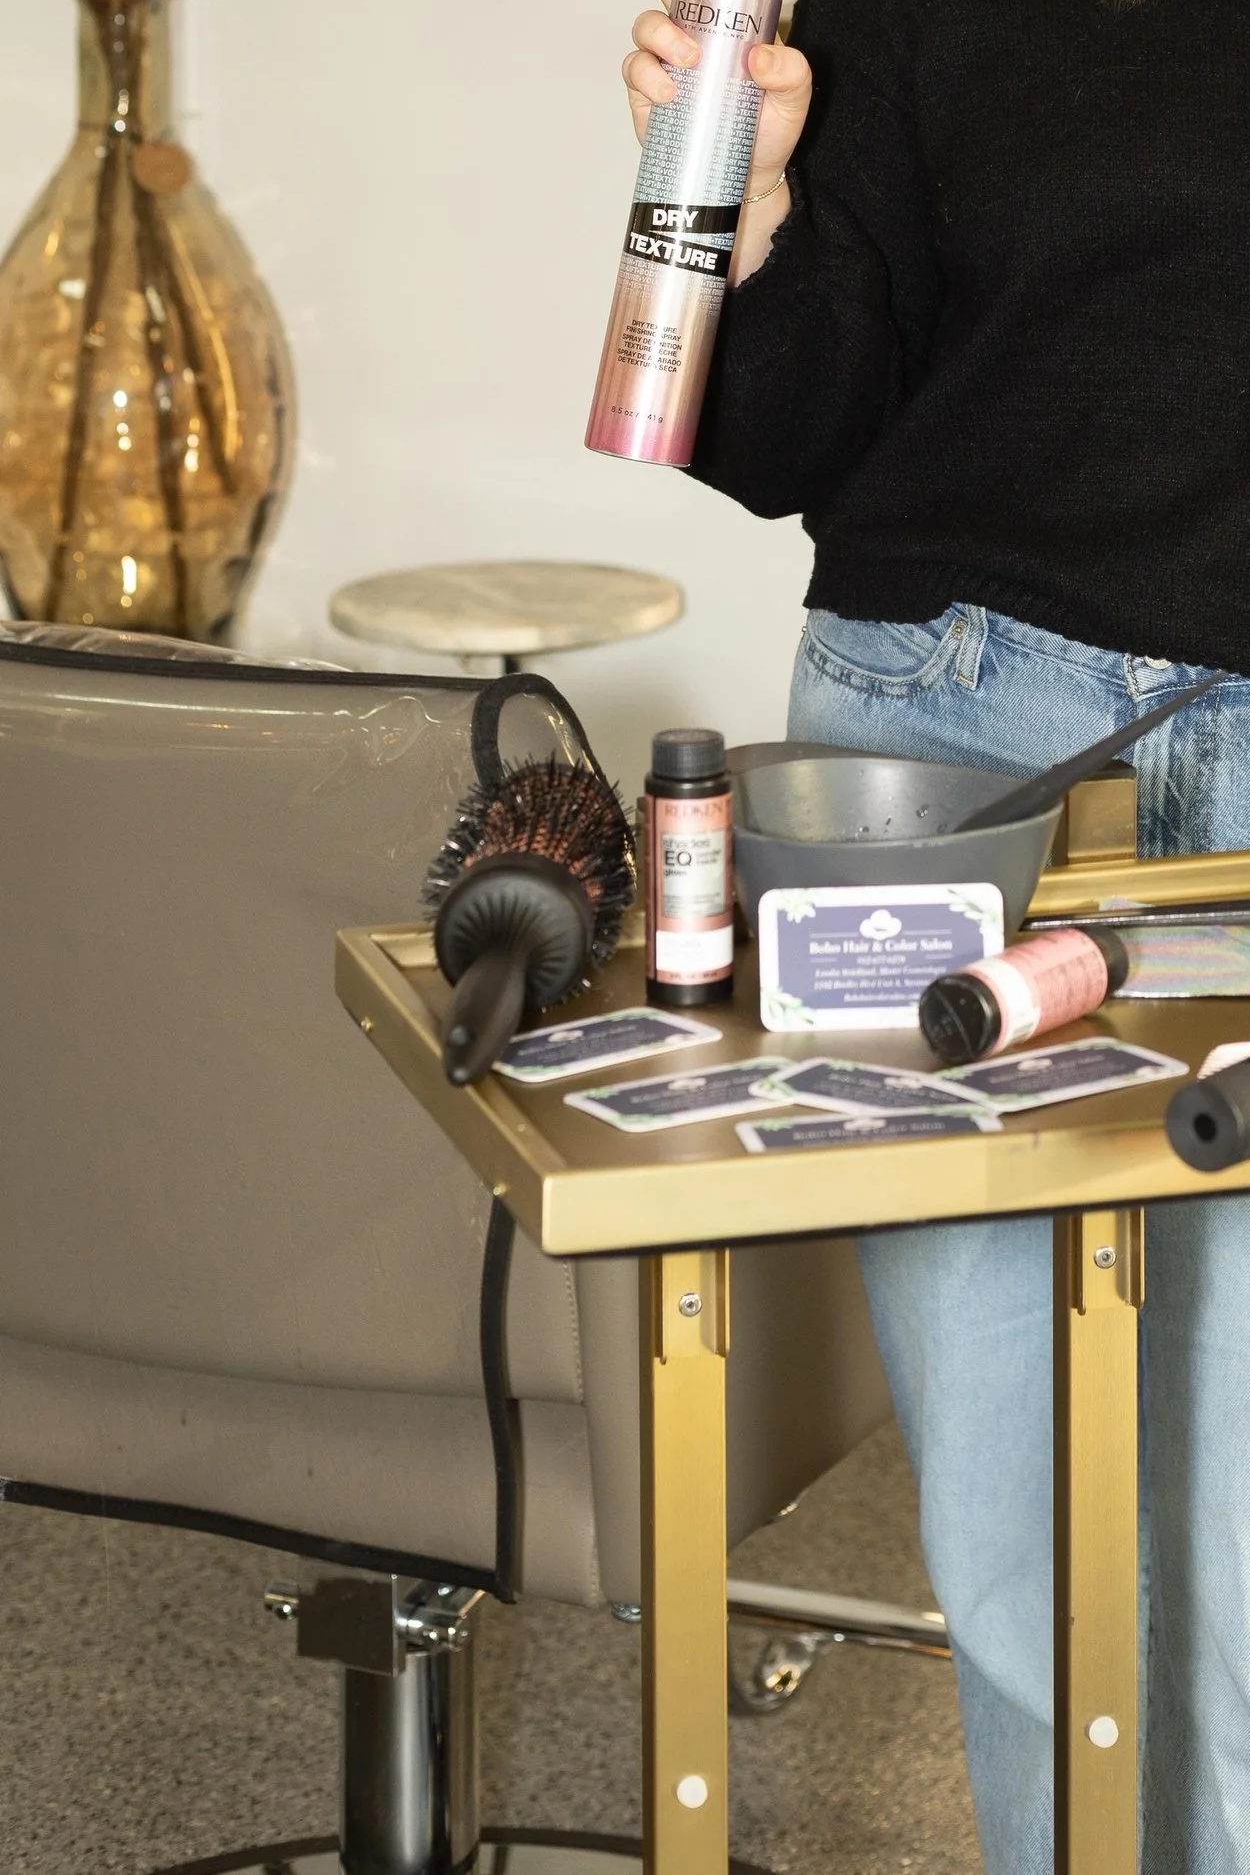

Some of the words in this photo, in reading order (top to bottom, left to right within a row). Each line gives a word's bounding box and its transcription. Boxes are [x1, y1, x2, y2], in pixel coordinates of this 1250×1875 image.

[675, 0, 763, 35] REDKEN
[652, 208, 699, 228] DRY
[629, 232, 718, 270] TEXTURE
[632, 319, 645, 327] DRY
[646, 322, 677, 334] TEXURE
[622, 333, 642, 343] SPRAY
[617, 348, 637, 358] SPRAY
[659, 365, 677, 373] SECA
[611, 406, 623, 414] 8.5
[664, 850, 692, 866] EQ
[843, 940, 870, 954] Hair
[872, 940, 883, 953] &
[885, 938, 918, 952] Color
[920, 937, 953, 951] Salon
